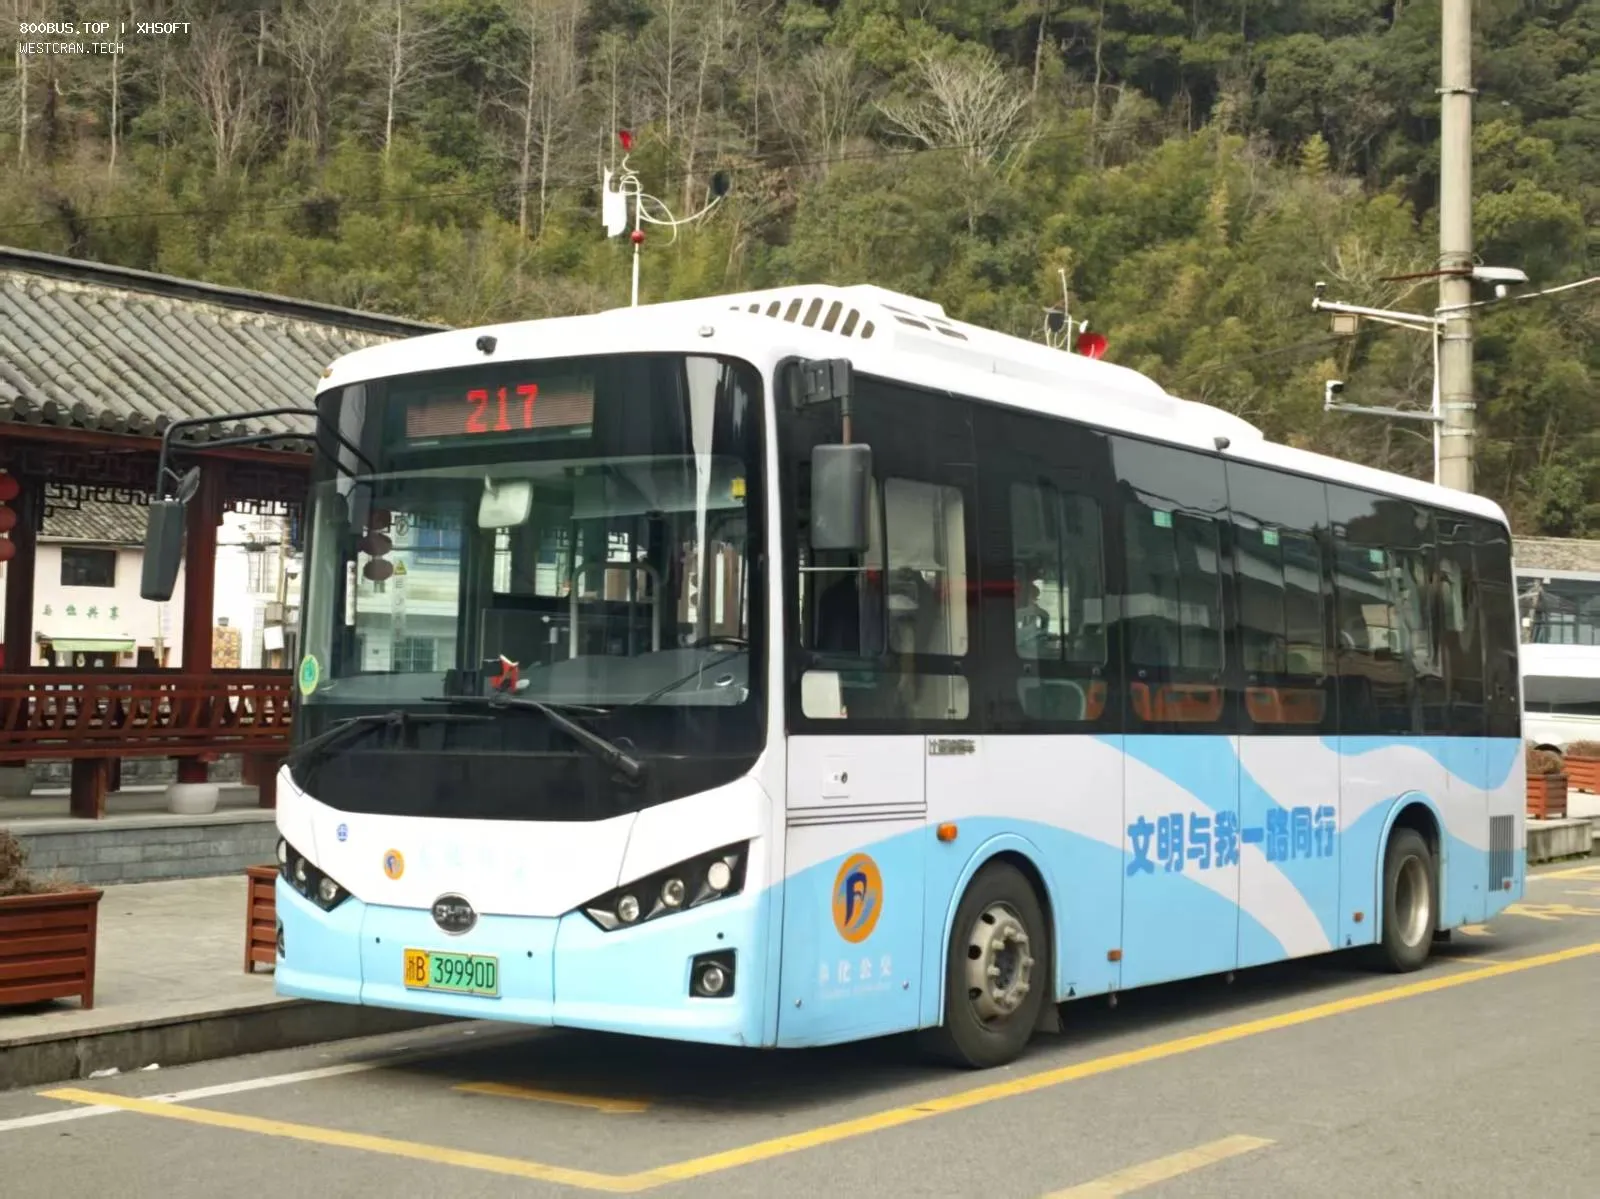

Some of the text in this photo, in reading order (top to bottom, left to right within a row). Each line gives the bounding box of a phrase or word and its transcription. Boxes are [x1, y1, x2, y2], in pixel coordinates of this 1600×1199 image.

[464, 383, 539, 433] 217
[1126, 804, 1336, 877] 文明与我一路同行
